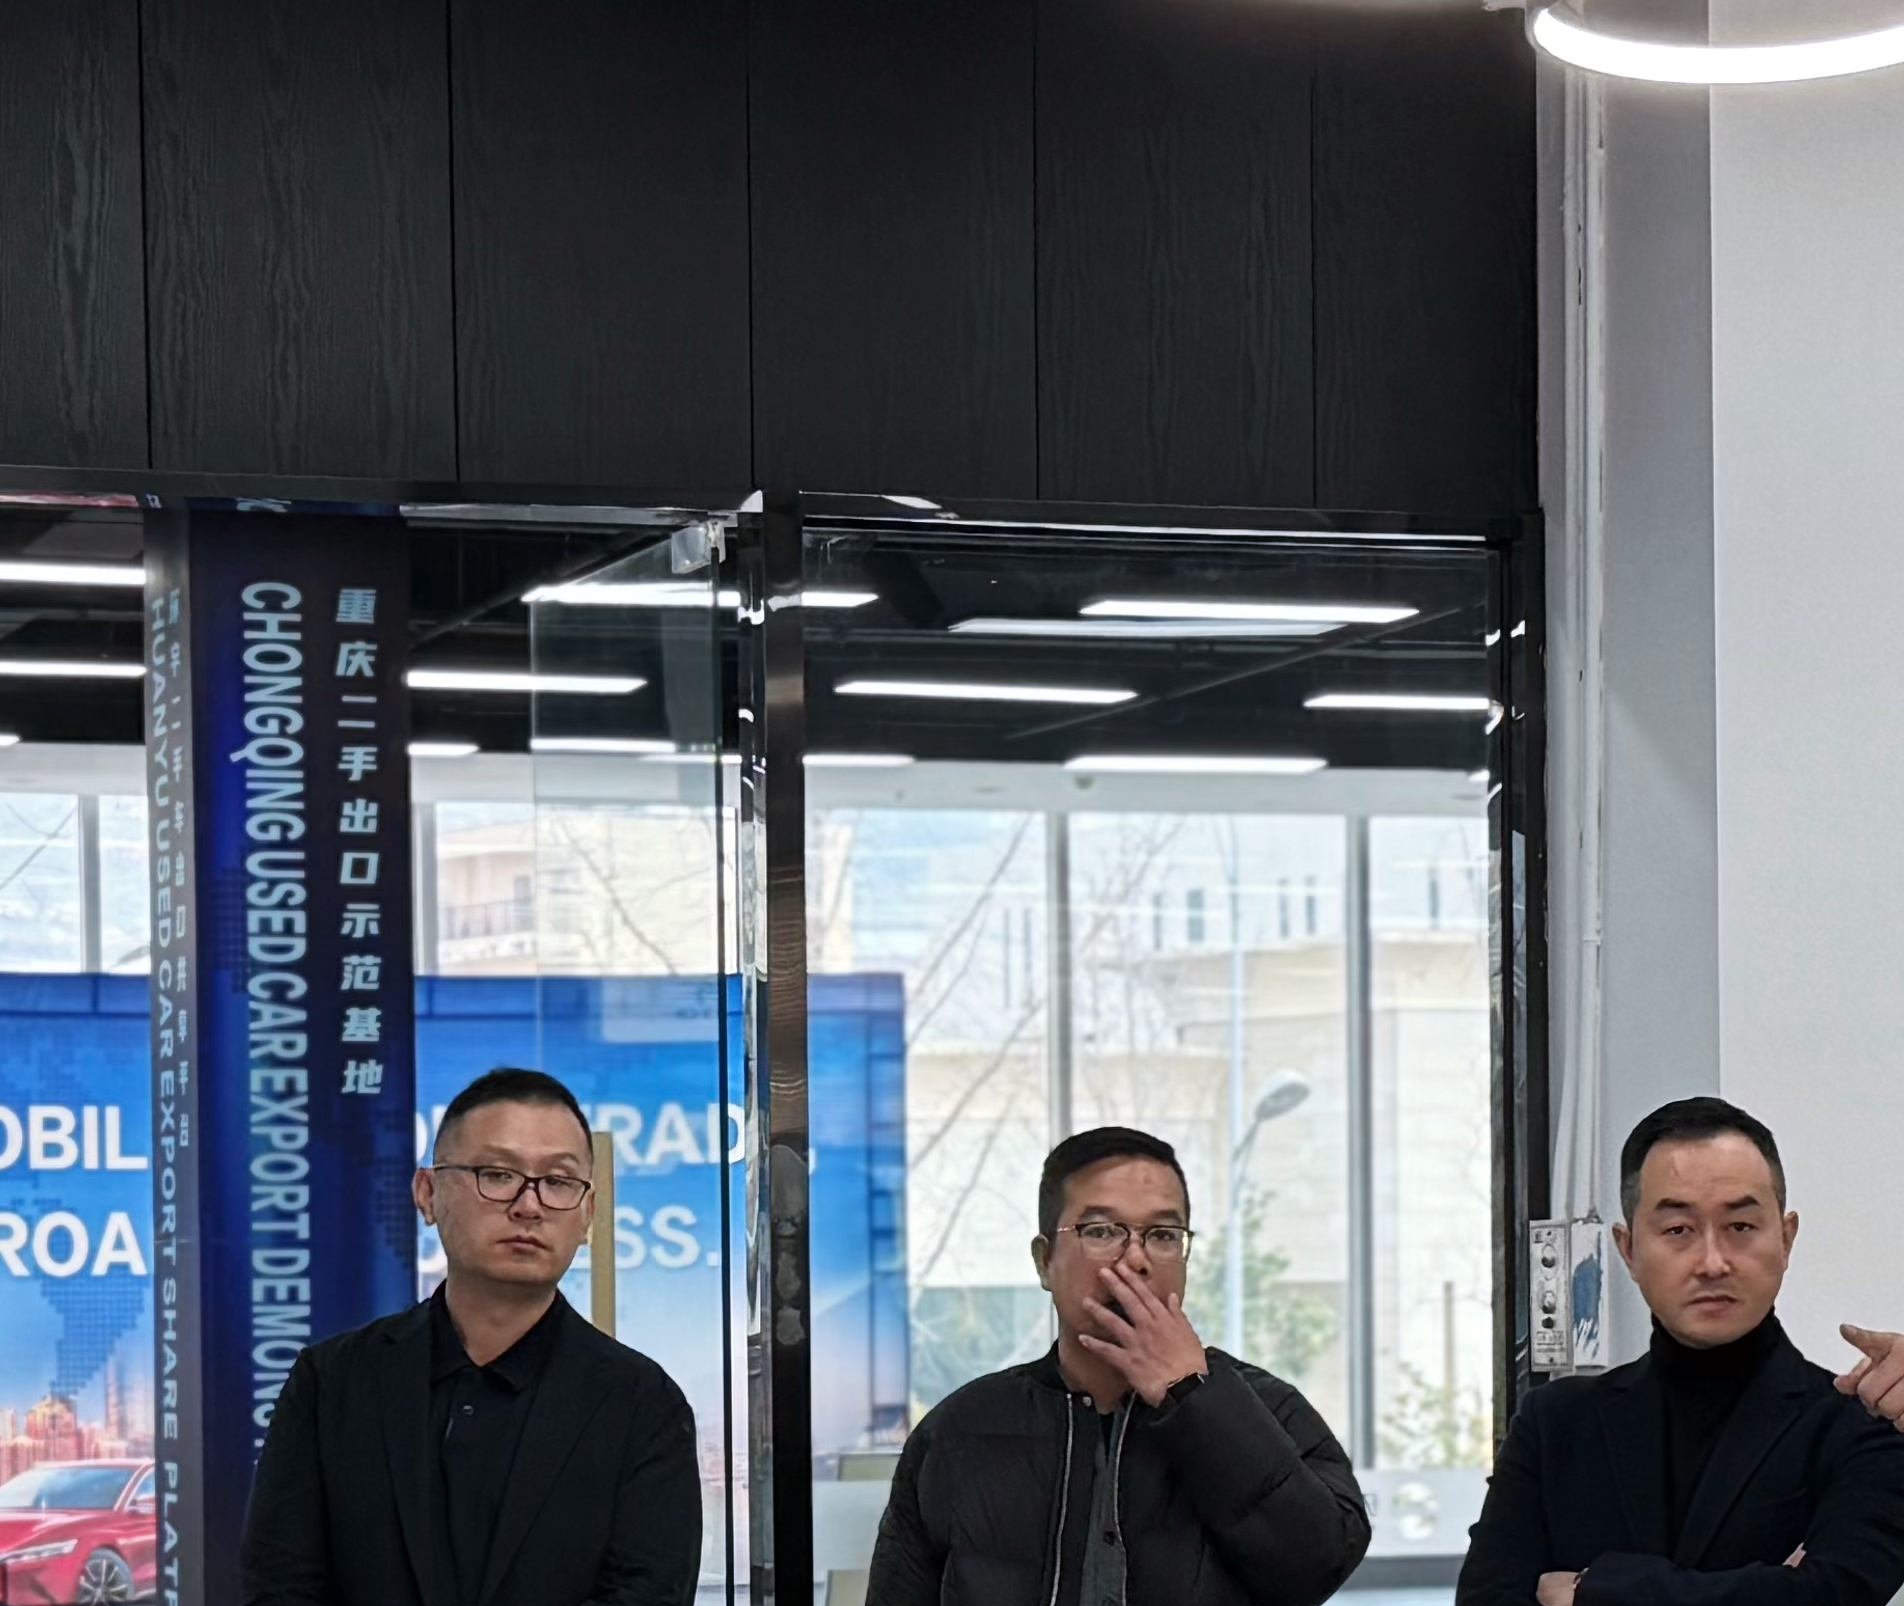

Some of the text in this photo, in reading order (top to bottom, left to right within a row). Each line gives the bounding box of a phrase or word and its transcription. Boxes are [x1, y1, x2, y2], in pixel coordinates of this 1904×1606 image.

[152, 597, 171, 807] HUANYU
[230, 582, 305, 840] CHONGQING
[156, 819, 172, 948] USED
[246, 852, 308, 962] USED
[335, 588, 383, 1095] 重庆二手出口示范基地
[159, 960, 174, 1059] CAR
[247, 972, 309, 1058] CAR
[160, 1070, 177, 1266] EXPORT
[250, 1069, 310, 1240] EXPORT
[162, 1278, 179, 1440] SHARE
